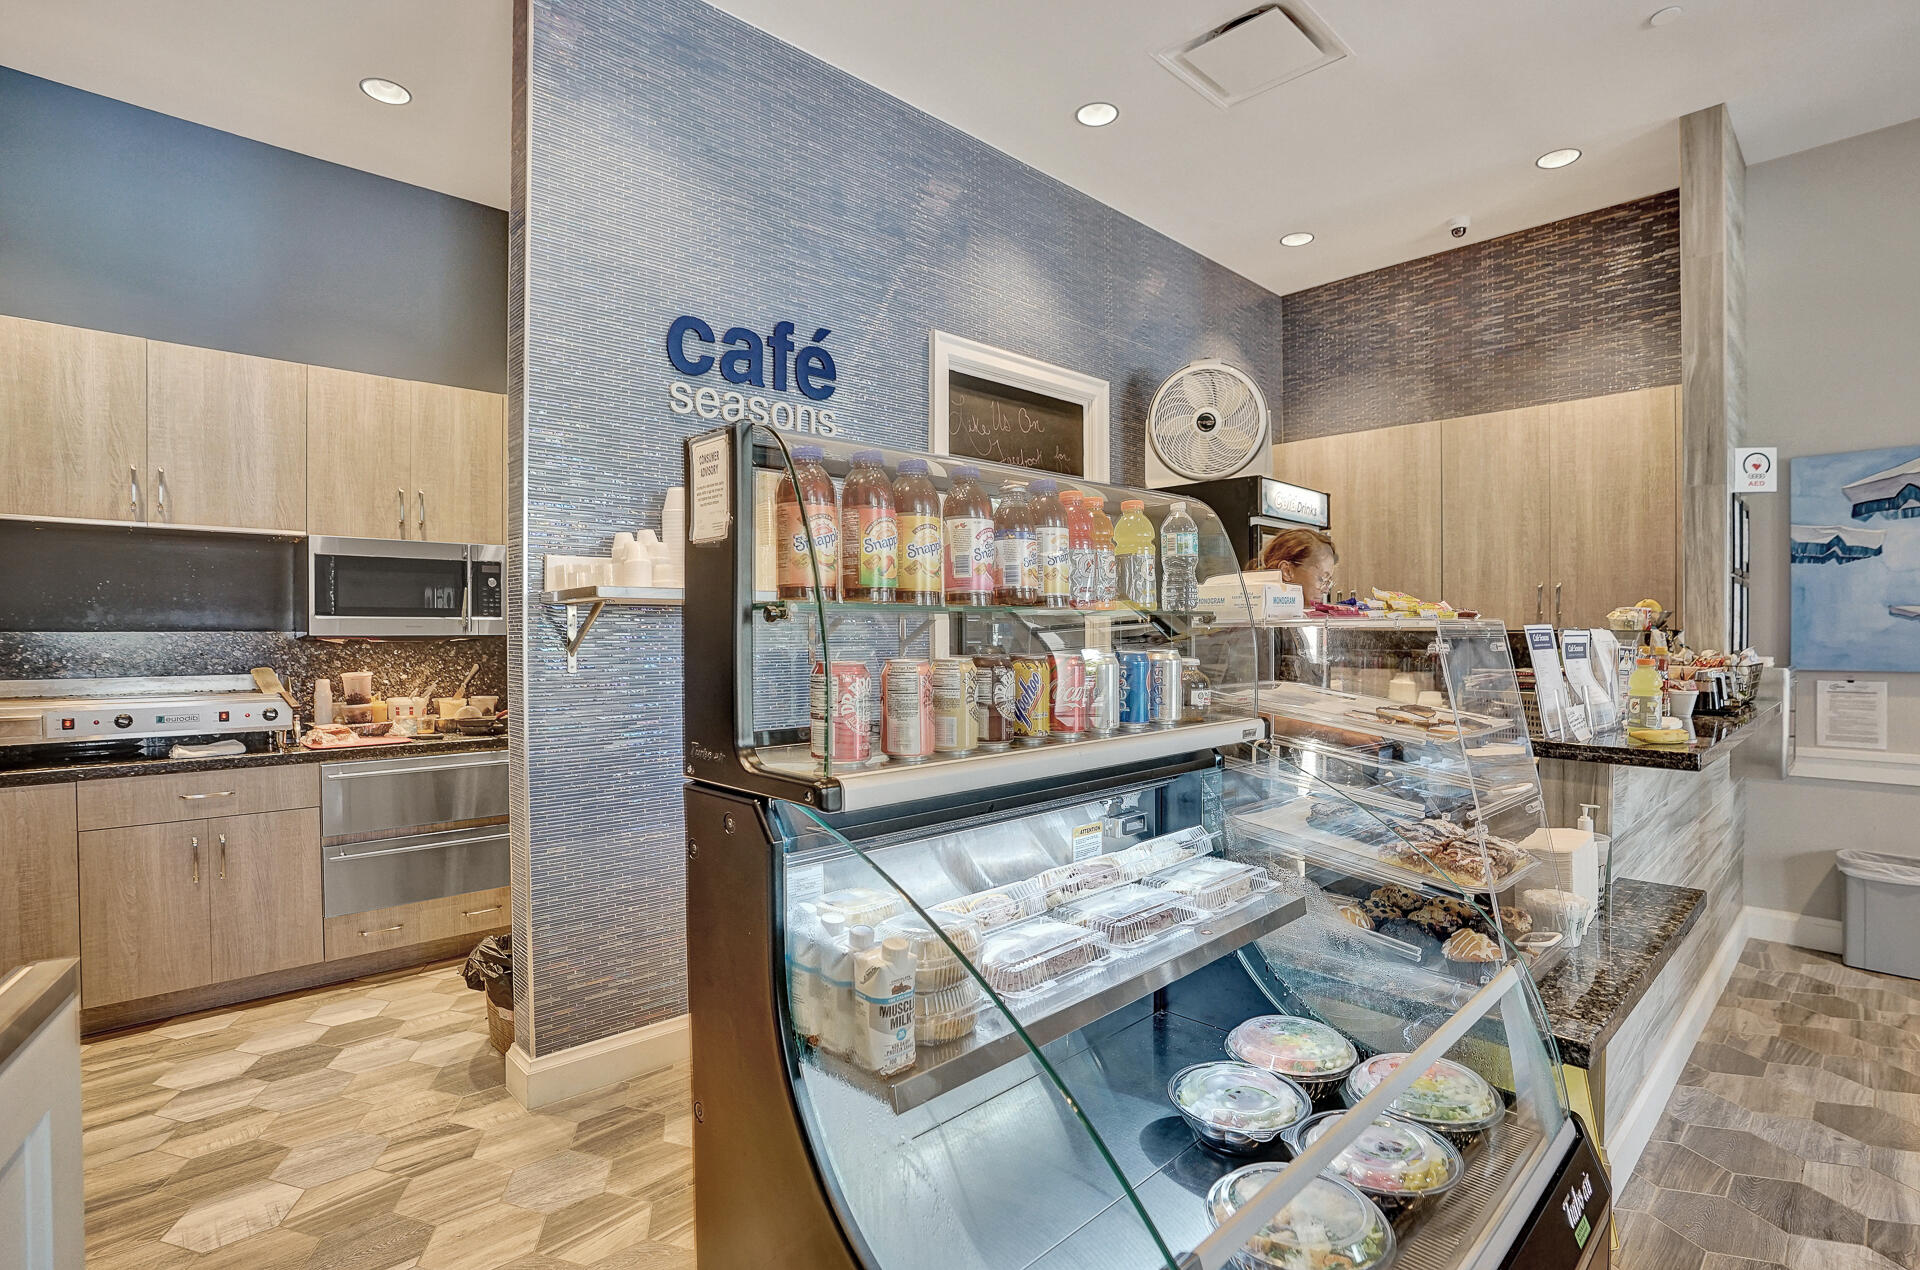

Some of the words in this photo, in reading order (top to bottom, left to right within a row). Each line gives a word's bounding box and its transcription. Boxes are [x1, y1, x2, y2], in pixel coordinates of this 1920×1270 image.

[666, 315, 837, 401] café
[669, 381, 840, 437] seasons
[950, 394, 991, 456] Like
[991, 401, 1011, 432] Us
[1018, 407, 1045, 434] On
[698, 450, 720, 465] CONSUMER
[700, 464, 719, 478] ADVISORY
[1297, 501, 1317, 517] Drinks
[1273, 596, 1296, 605] MONOGRAM
[1153, 663, 1166, 706] pepsi
[165, 714, 199, 723] eurodib
[1080, 825, 1101, 835] ATTENTION
[890, 1014, 913, 1030] MILK
